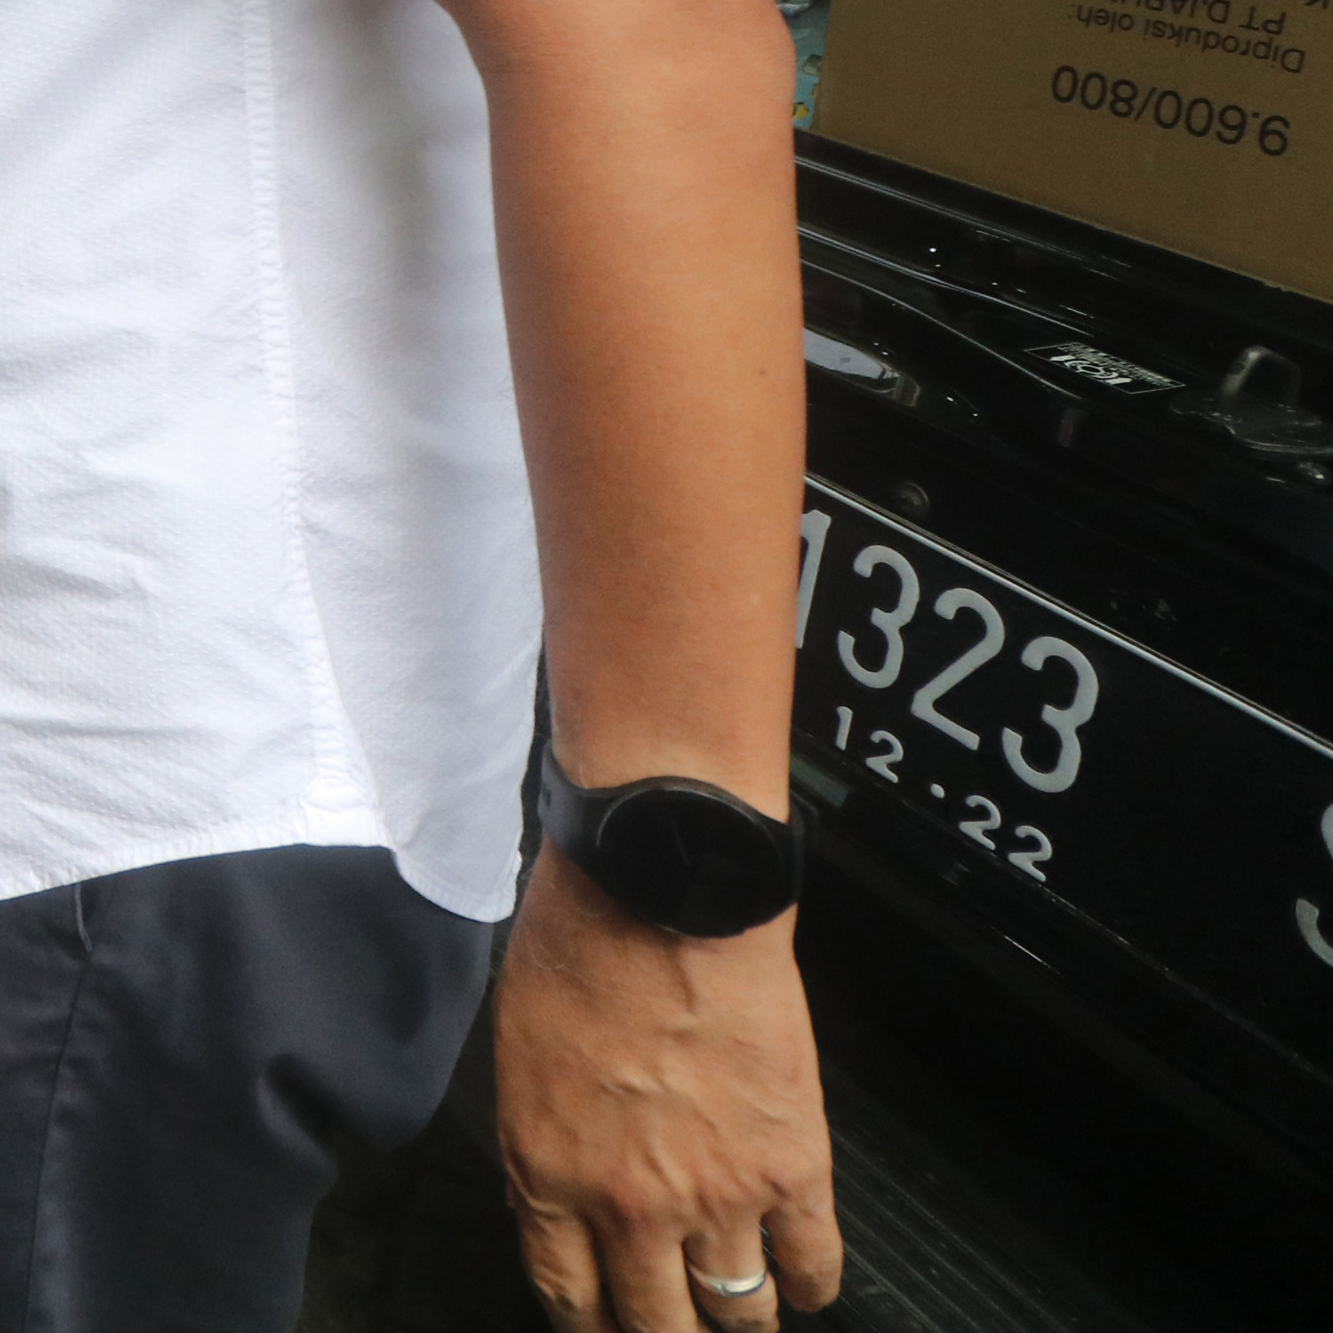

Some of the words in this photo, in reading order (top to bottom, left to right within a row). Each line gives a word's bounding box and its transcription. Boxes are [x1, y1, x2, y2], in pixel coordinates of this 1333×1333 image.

[1068, 4, 1134, 38] oleh:
[1142, 18, 1307, 75] Diproduksi
[1238, 6, 1287, 36] PT
[1052, 65, 1292, 158] 9.600/800
[795, 507, 1099, 794] 1323
